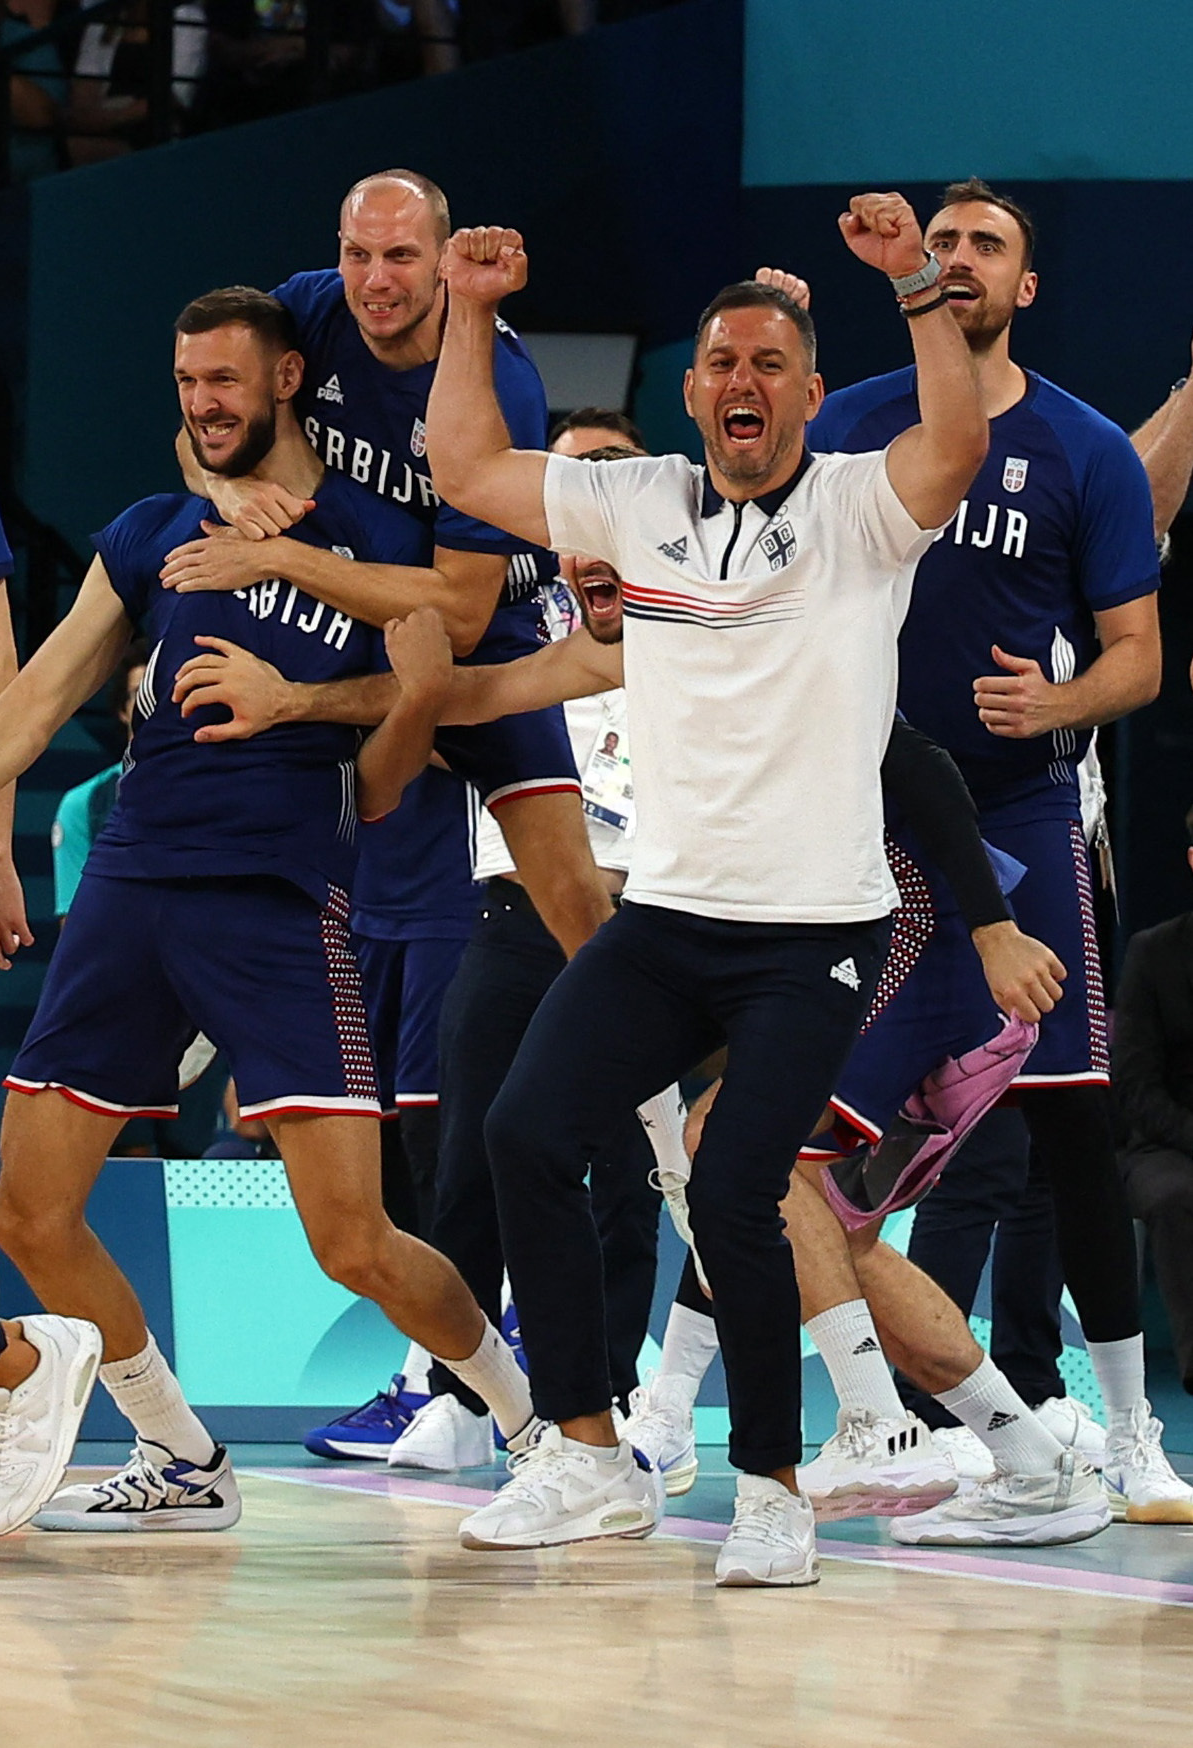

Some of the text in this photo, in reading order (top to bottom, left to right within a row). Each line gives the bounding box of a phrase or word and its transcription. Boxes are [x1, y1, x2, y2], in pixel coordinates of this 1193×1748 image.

[316, 386, 345, 405] PEAK
[933, 499, 1028, 559] IJA
[233, 577, 353, 651] BIJA
[830, 965, 862, 992] PEAK
